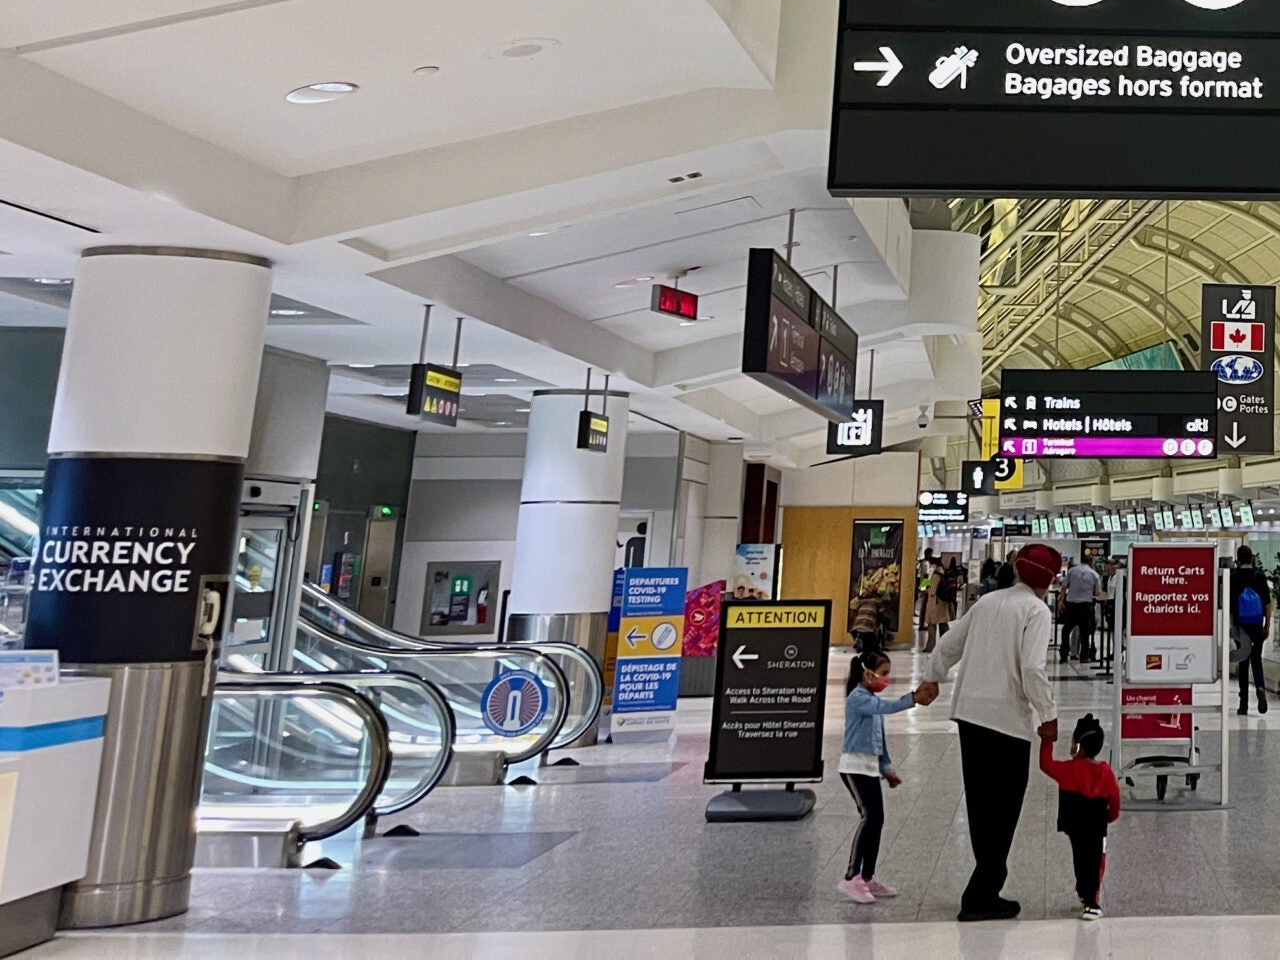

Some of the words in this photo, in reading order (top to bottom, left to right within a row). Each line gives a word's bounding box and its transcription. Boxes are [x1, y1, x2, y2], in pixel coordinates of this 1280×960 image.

[1005, 43, 1129, 68] Oversized
[1136, 45, 1242, 73] Baggage
[1005, 74, 1113, 100] Bagages
[1119, 74, 1172, 97] hors
[1180, 74, 1264, 99] format
[1044, 396, 1081, 409] Trains
[1240, 395, 1265, 404] Gates
[1240, 404, 1269, 414] Portes
[1042, 418, 1082, 431] Hotels
[1093, 417, 1132, 432] Hôtels
[995, 458, 1009, 478] 3
[45, 526, 198, 538] INTERNATIONAL
[42, 540, 196, 564] CURRENCY
[1141, 566, 1174, 576] Return
[1178, 566, 1204, 576] Carts
[38, 568, 191, 593] EXCHANGE
[630, 578, 679, 586] DEPARTURES
[1161, 576, 1188, 585] Here.
[628, 586, 666, 595] COVID-19
[628, 596, 661, 604] TESTING
[1136, 592, 1188, 603] Rapportez
[1144, 604, 1184, 614] chariots
[1188, 604, 1201, 614] ici.
[736, 612, 818, 623] ATTENTION
[622, 662, 664, 673] DÉPISTAGE
[666, 663, 677, 671] DE
[767, 661, 814, 669] SHERATON
[620, 674, 631, 682] LA
[633, 673, 671, 682] COVID-19
[619, 682, 643, 690] POUR
[645, 682, 658, 690] LES
[619, 690, 654, 700] DÉPARTS
[722, 721, 743, 729] Accès
[745, 722, 760, 730] pour
[763, 720, 782, 729] Hôtel
